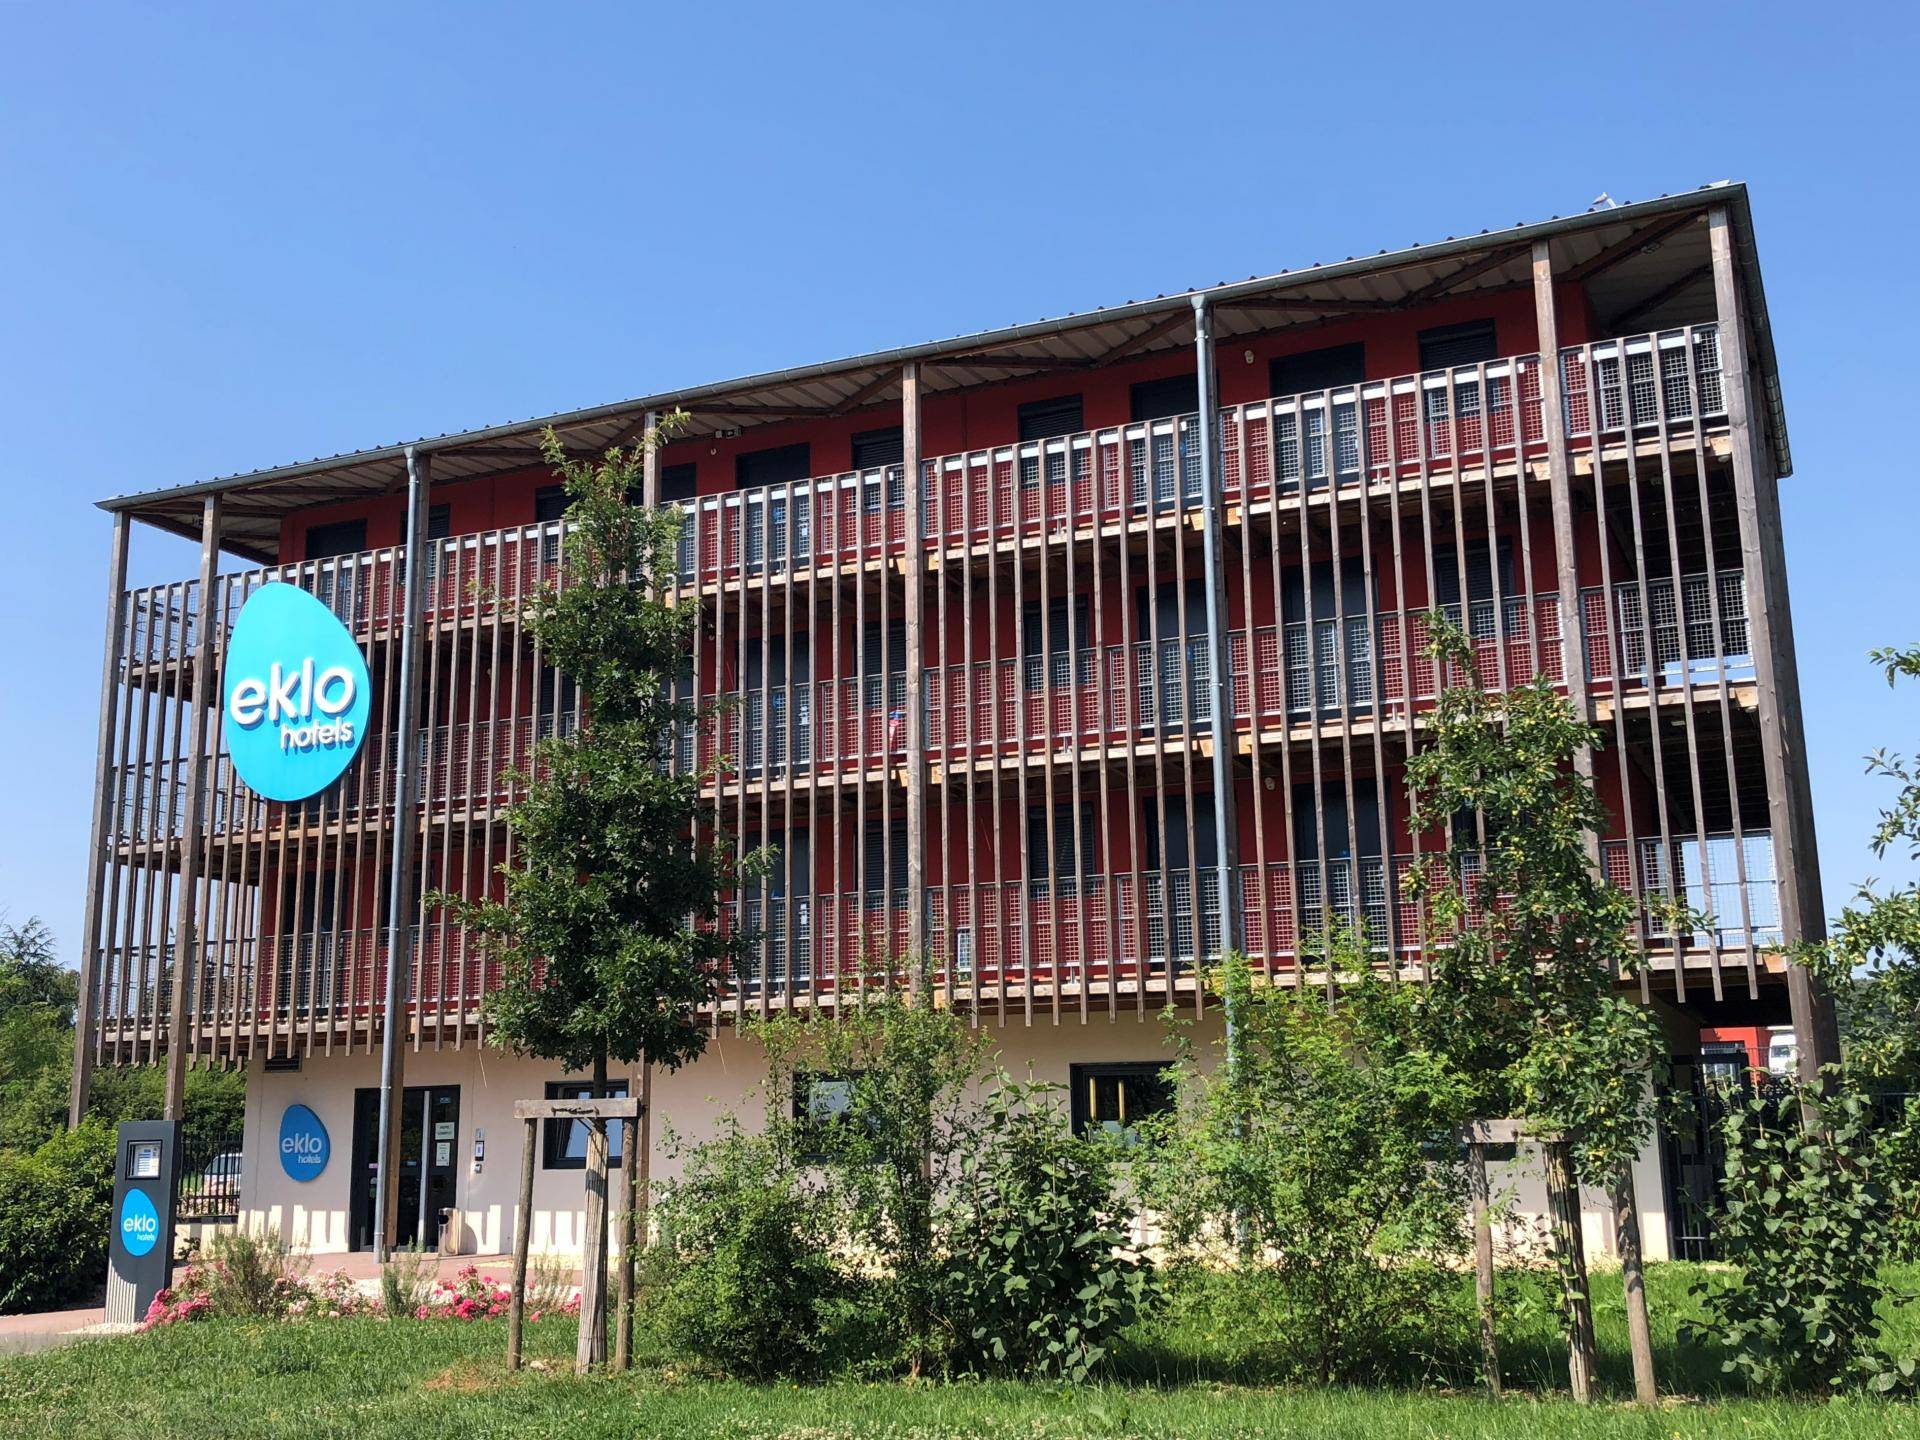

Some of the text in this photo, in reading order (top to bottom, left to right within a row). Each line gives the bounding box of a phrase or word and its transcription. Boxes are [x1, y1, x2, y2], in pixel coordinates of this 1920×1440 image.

[230, 657, 355, 725] eklo
[280, 717, 353, 749] hotels
[281, 1133, 321, 1153] eklo
[298, 1154, 321, 1163] hotels
[124, 1213, 156, 1232] eklo
